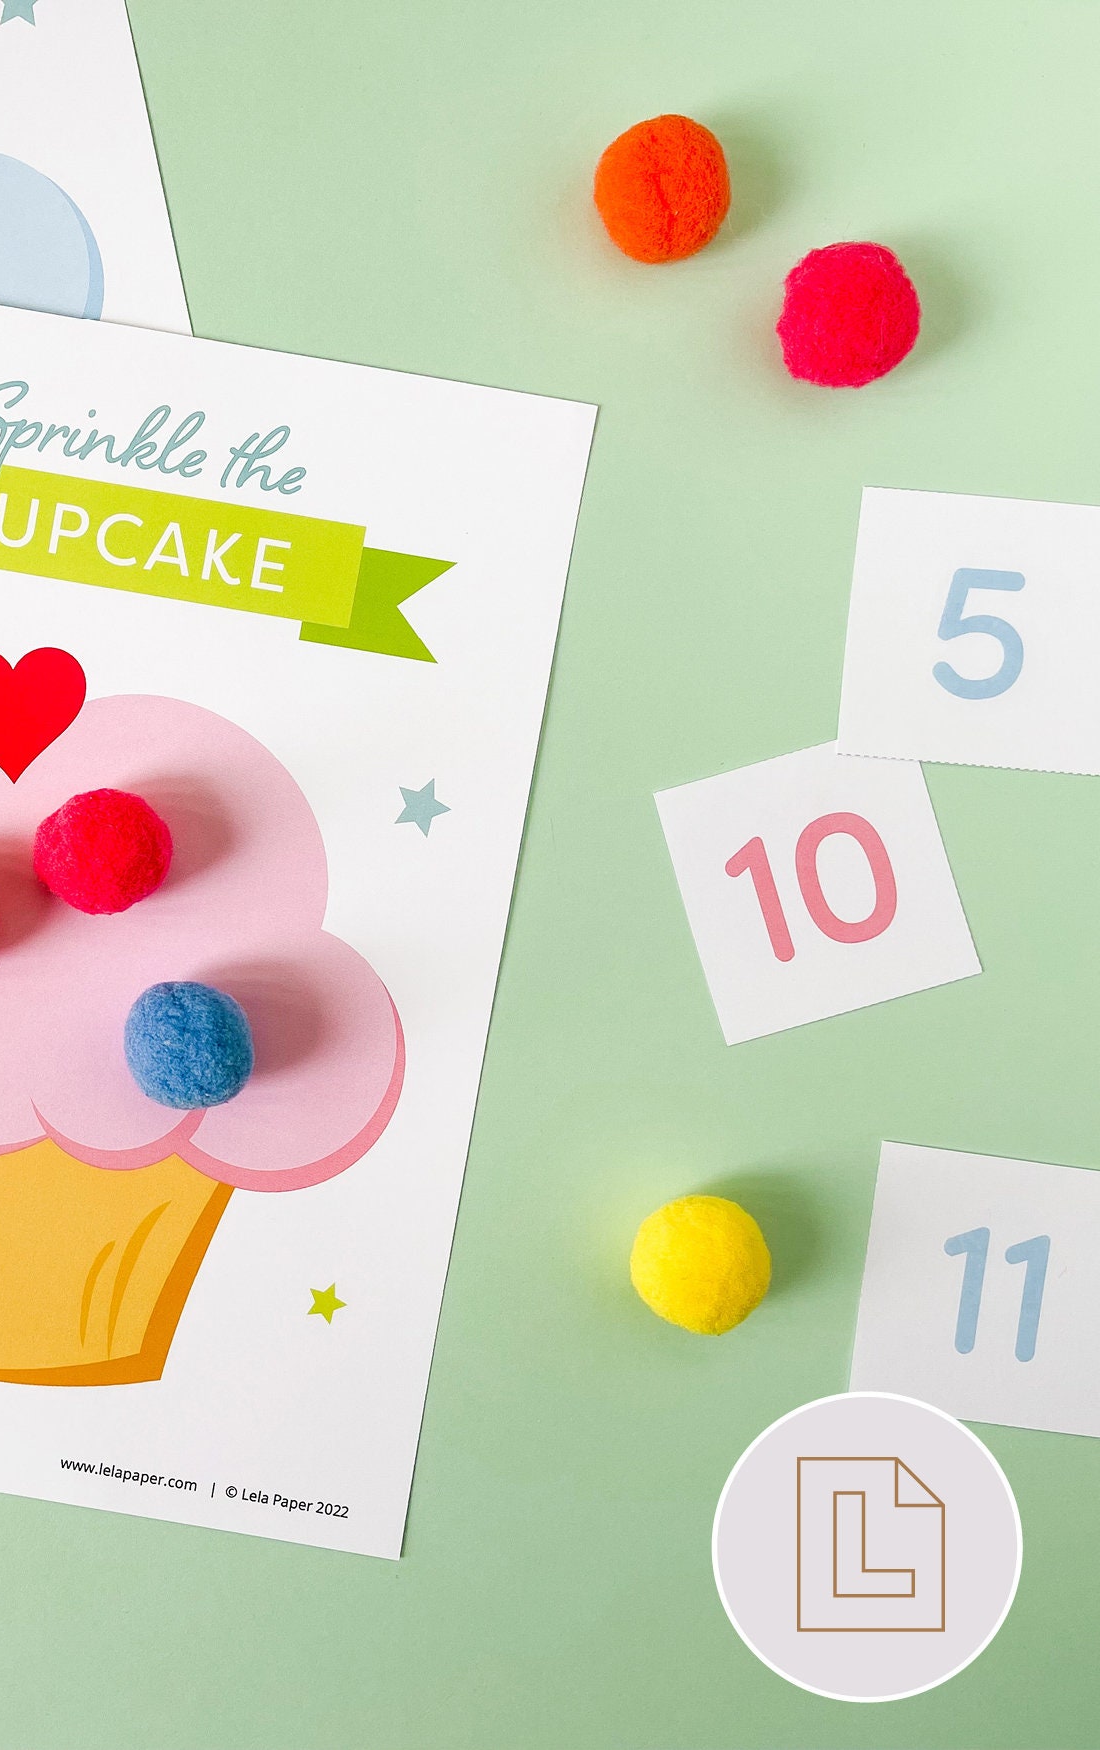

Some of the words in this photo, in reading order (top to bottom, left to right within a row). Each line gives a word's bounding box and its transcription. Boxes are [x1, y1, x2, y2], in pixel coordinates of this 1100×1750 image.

[219, 425, 307, 495] the
[932, 567, 1026, 700] 5
[724, 811, 898, 962] 10
[943, 1226, 1051, 1363] 11
[59, 1458, 198, 1492] www.lelapaper.com
[241, 1488, 270, 1505] Lela
[272, 1493, 313, 1513] Paper
[315, 1501, 350, 1519] 2022
